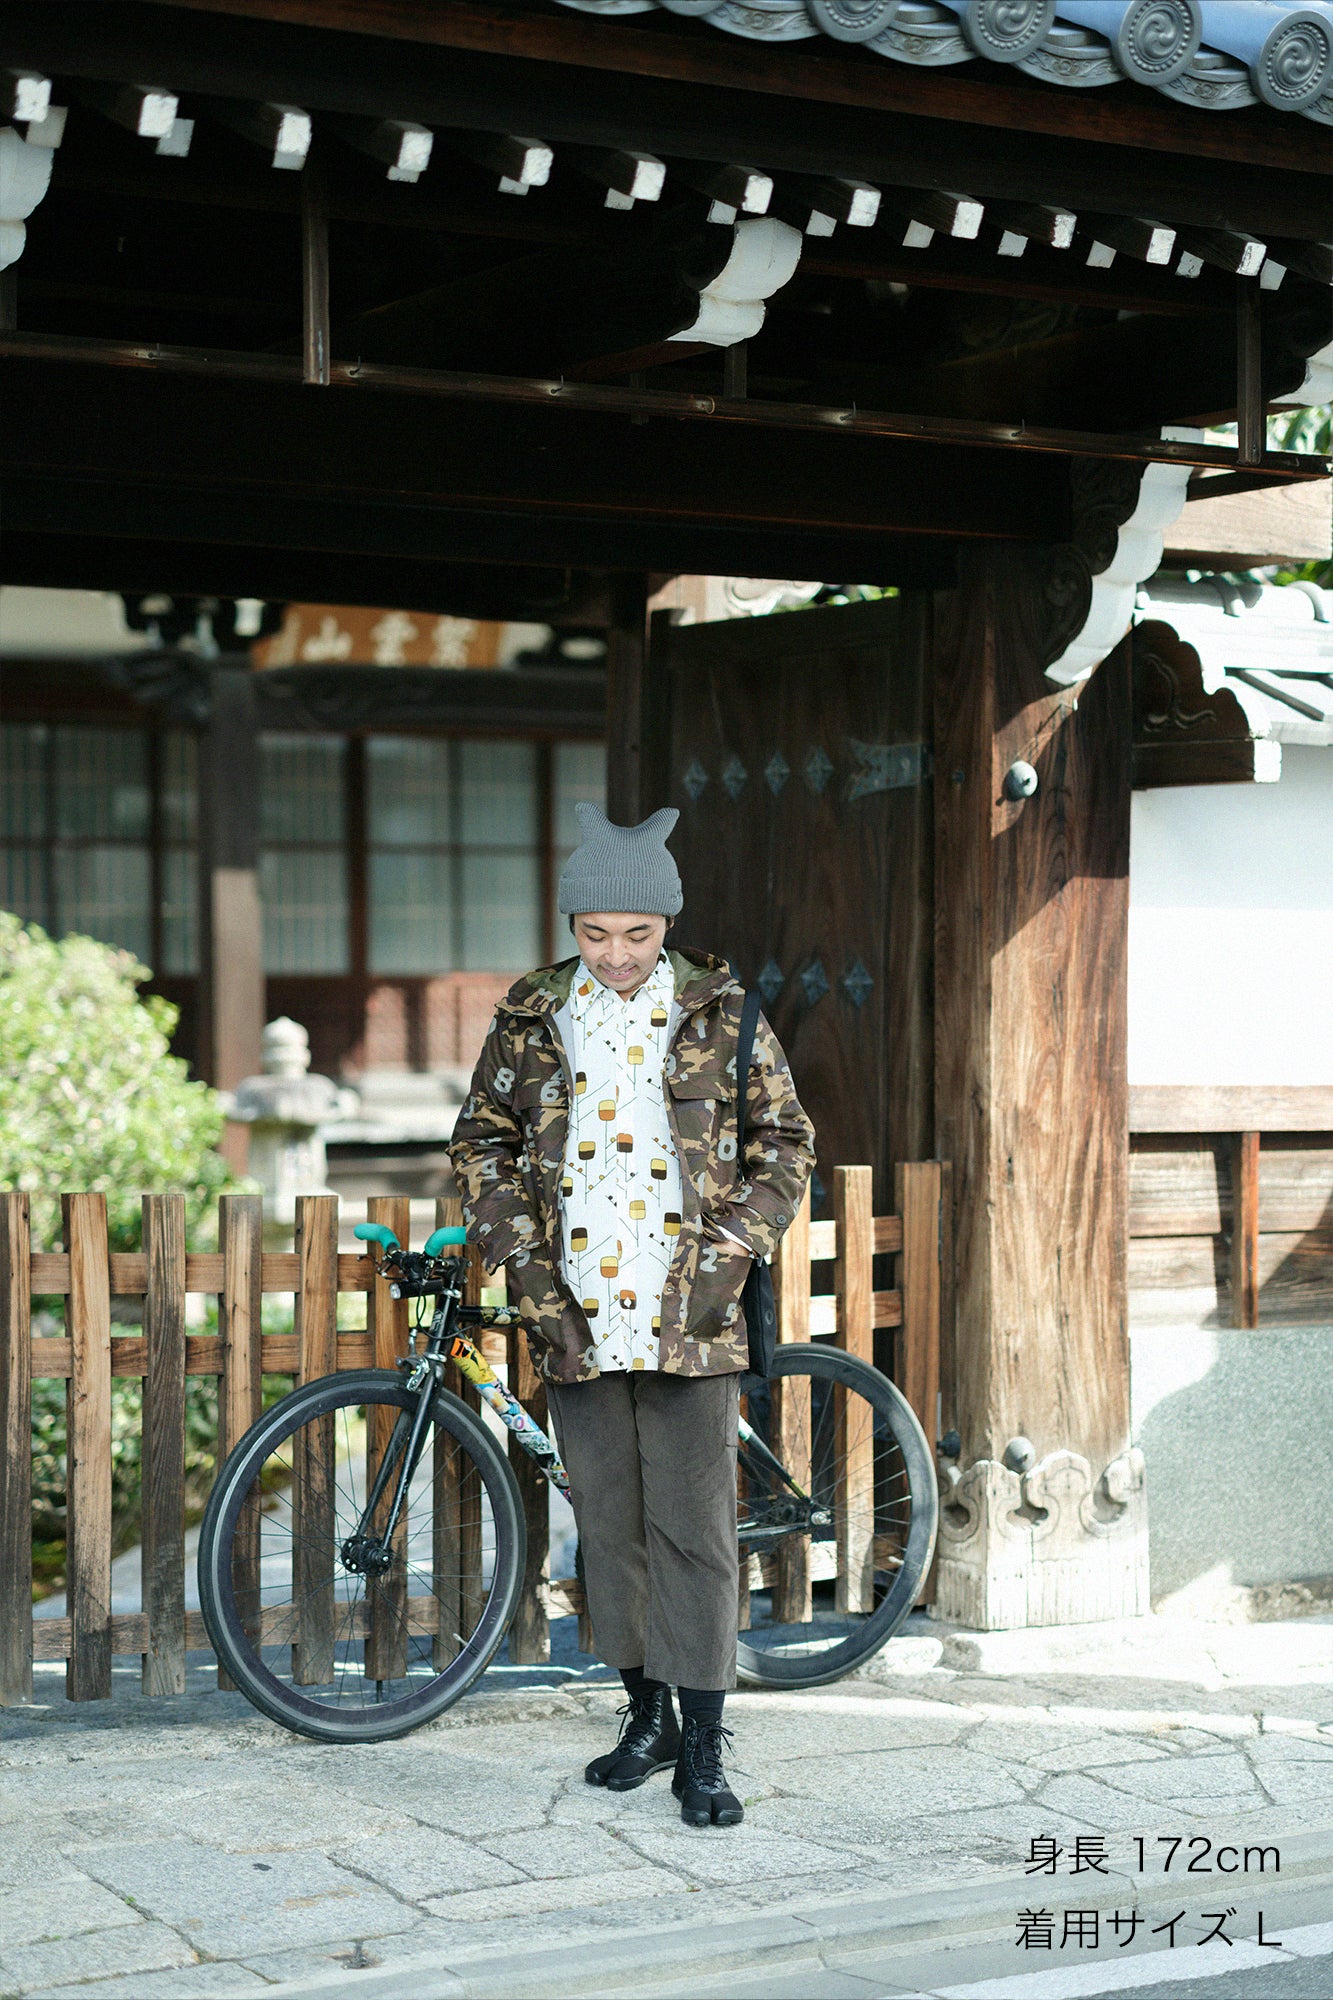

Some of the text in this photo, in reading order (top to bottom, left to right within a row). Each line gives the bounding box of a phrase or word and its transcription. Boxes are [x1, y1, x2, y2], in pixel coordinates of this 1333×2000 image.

[493, 1067, 516, 1094] 8
[540, 1081, 562, 1103] 6
[717, 1137, 737, 1162] 0
[700, 1248, 718, 1273] 2
